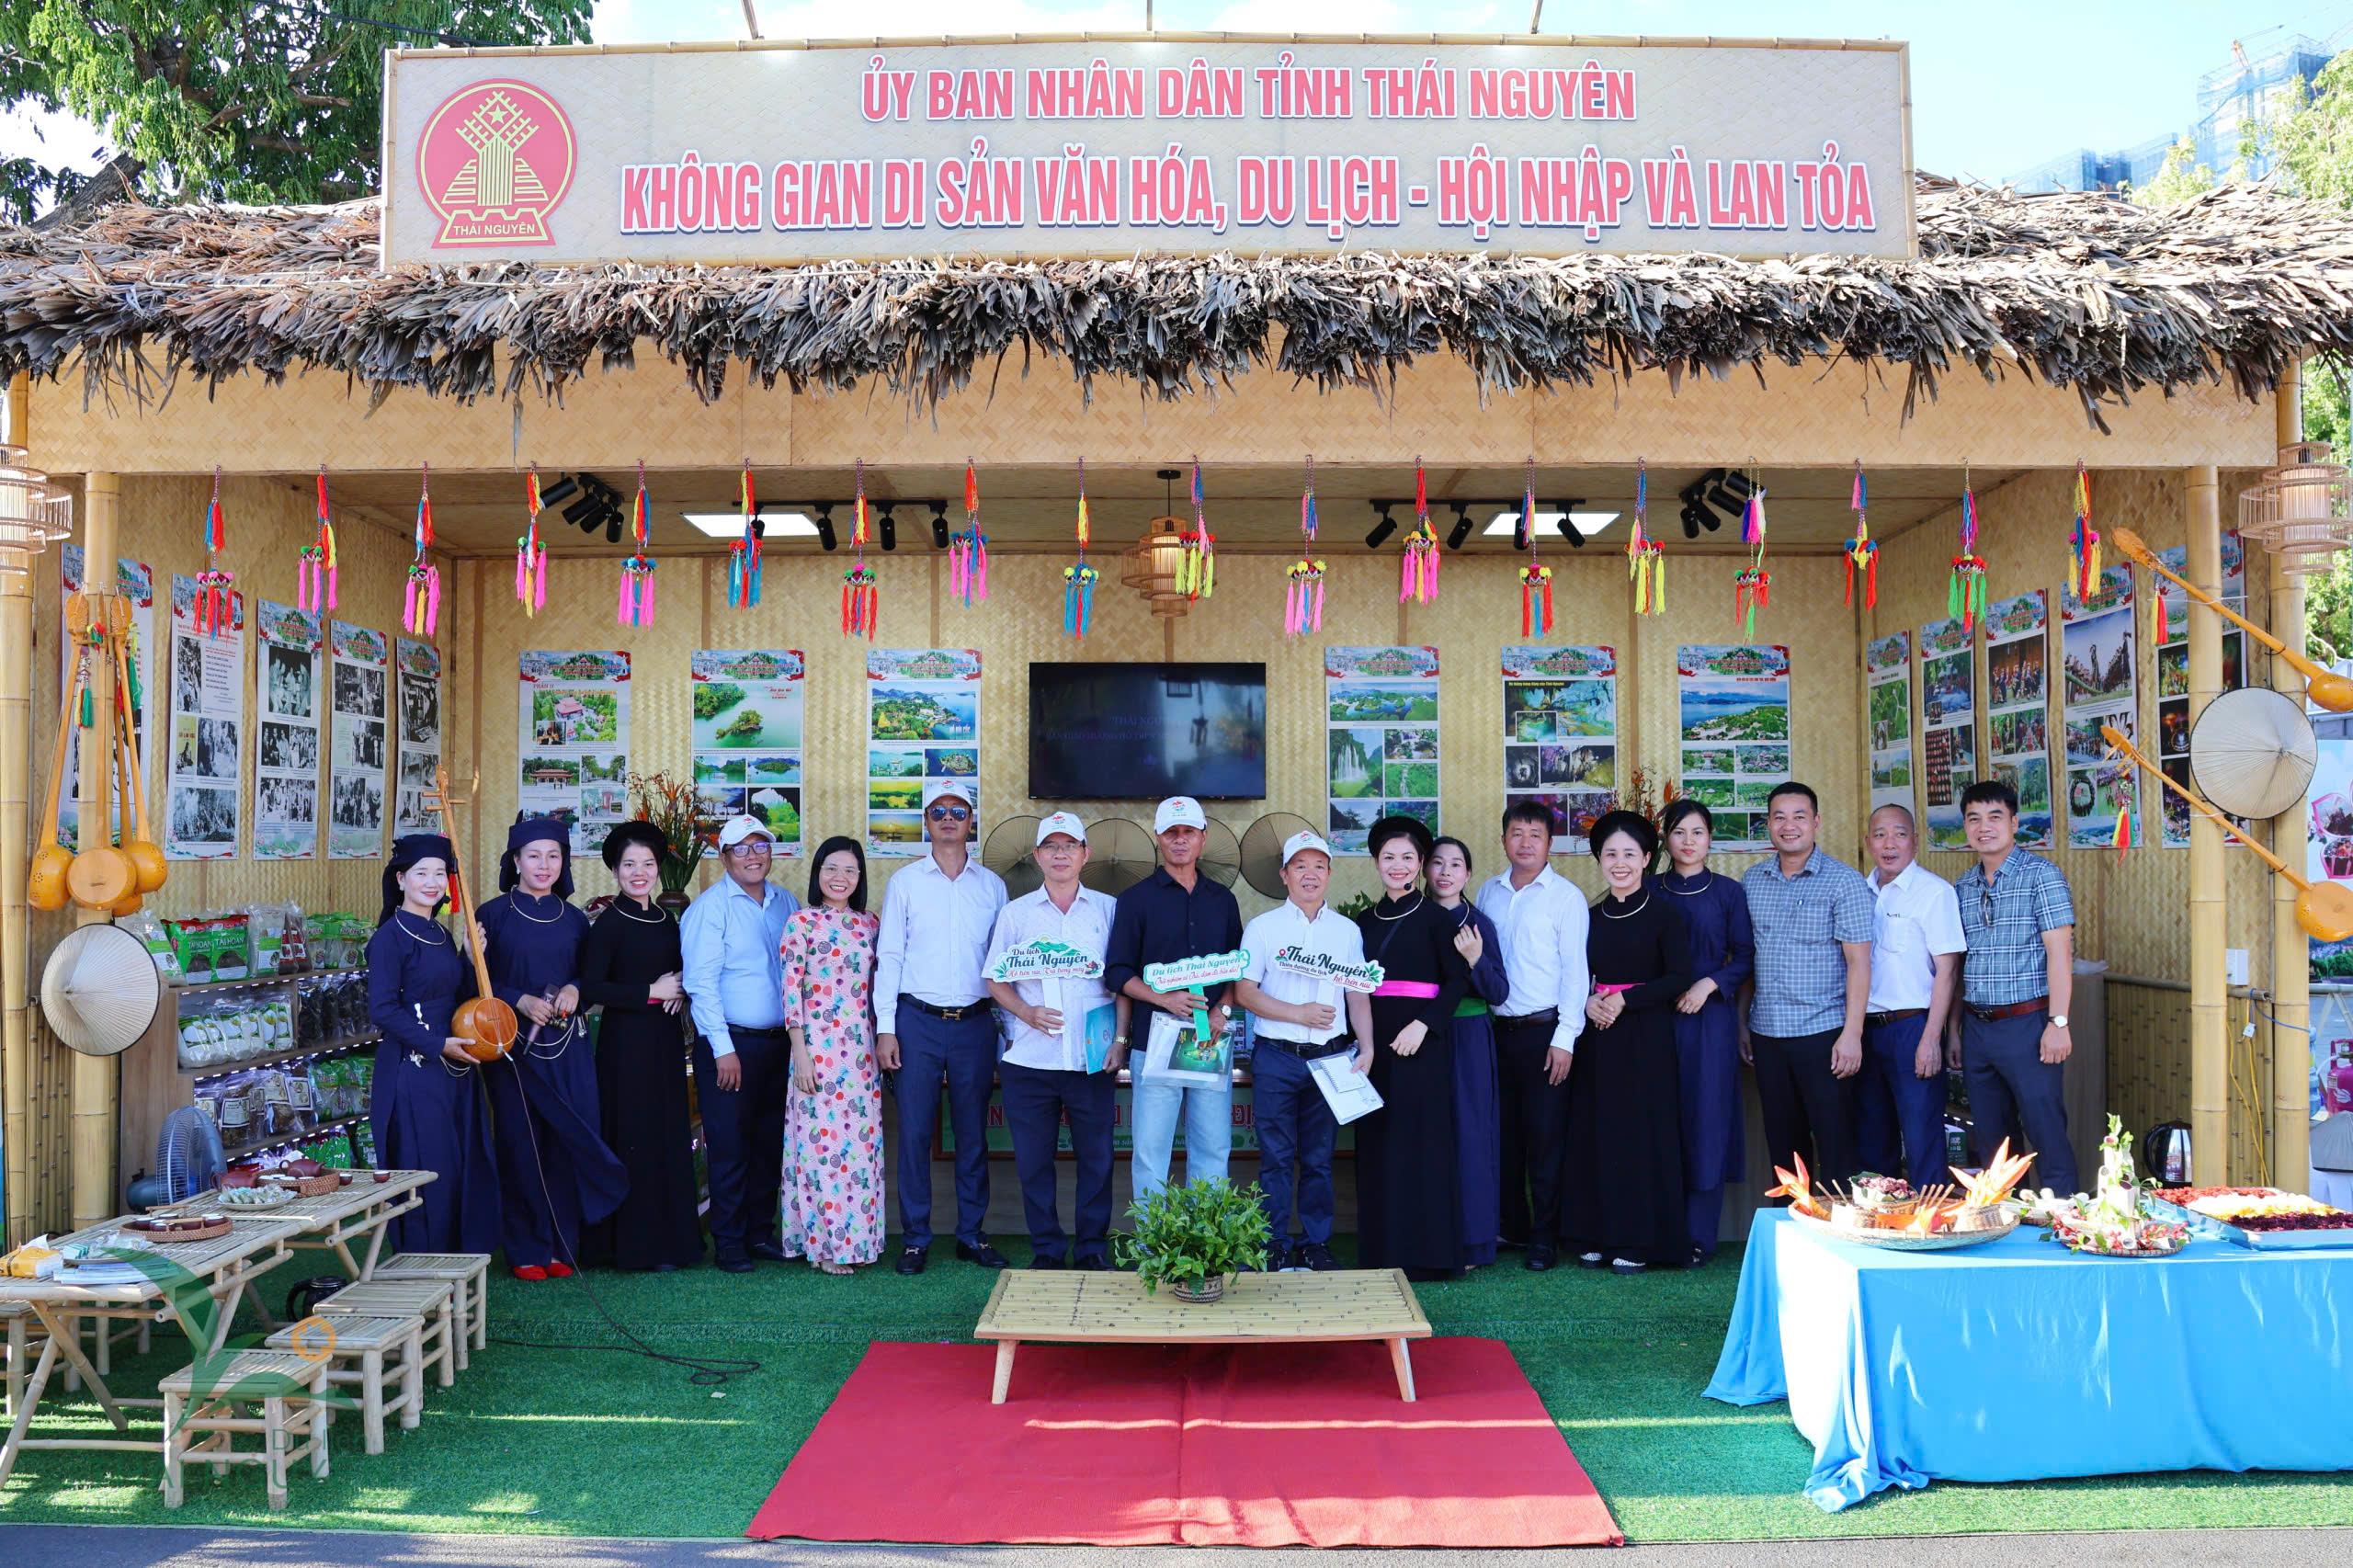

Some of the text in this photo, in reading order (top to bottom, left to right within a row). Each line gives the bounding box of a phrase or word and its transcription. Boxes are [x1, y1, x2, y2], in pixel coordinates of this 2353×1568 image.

[862, 51, 1636, 120] ỦY BAN NHÂN DÂN TỈNH THÁI NGUYÊN
[622, 137, 1875, 238] KHÔNG GIAN DI SẢN VĂN HÓA, DU LỊCH - HỘI NHẬP VÀ LAN TỎA
[454, 222, 535, 235] THÁI NGUYÊN
[1006, 953, 1088, 968] Thái Nguyên
[1287, 946, 1368, 978] Thái Nguyên
